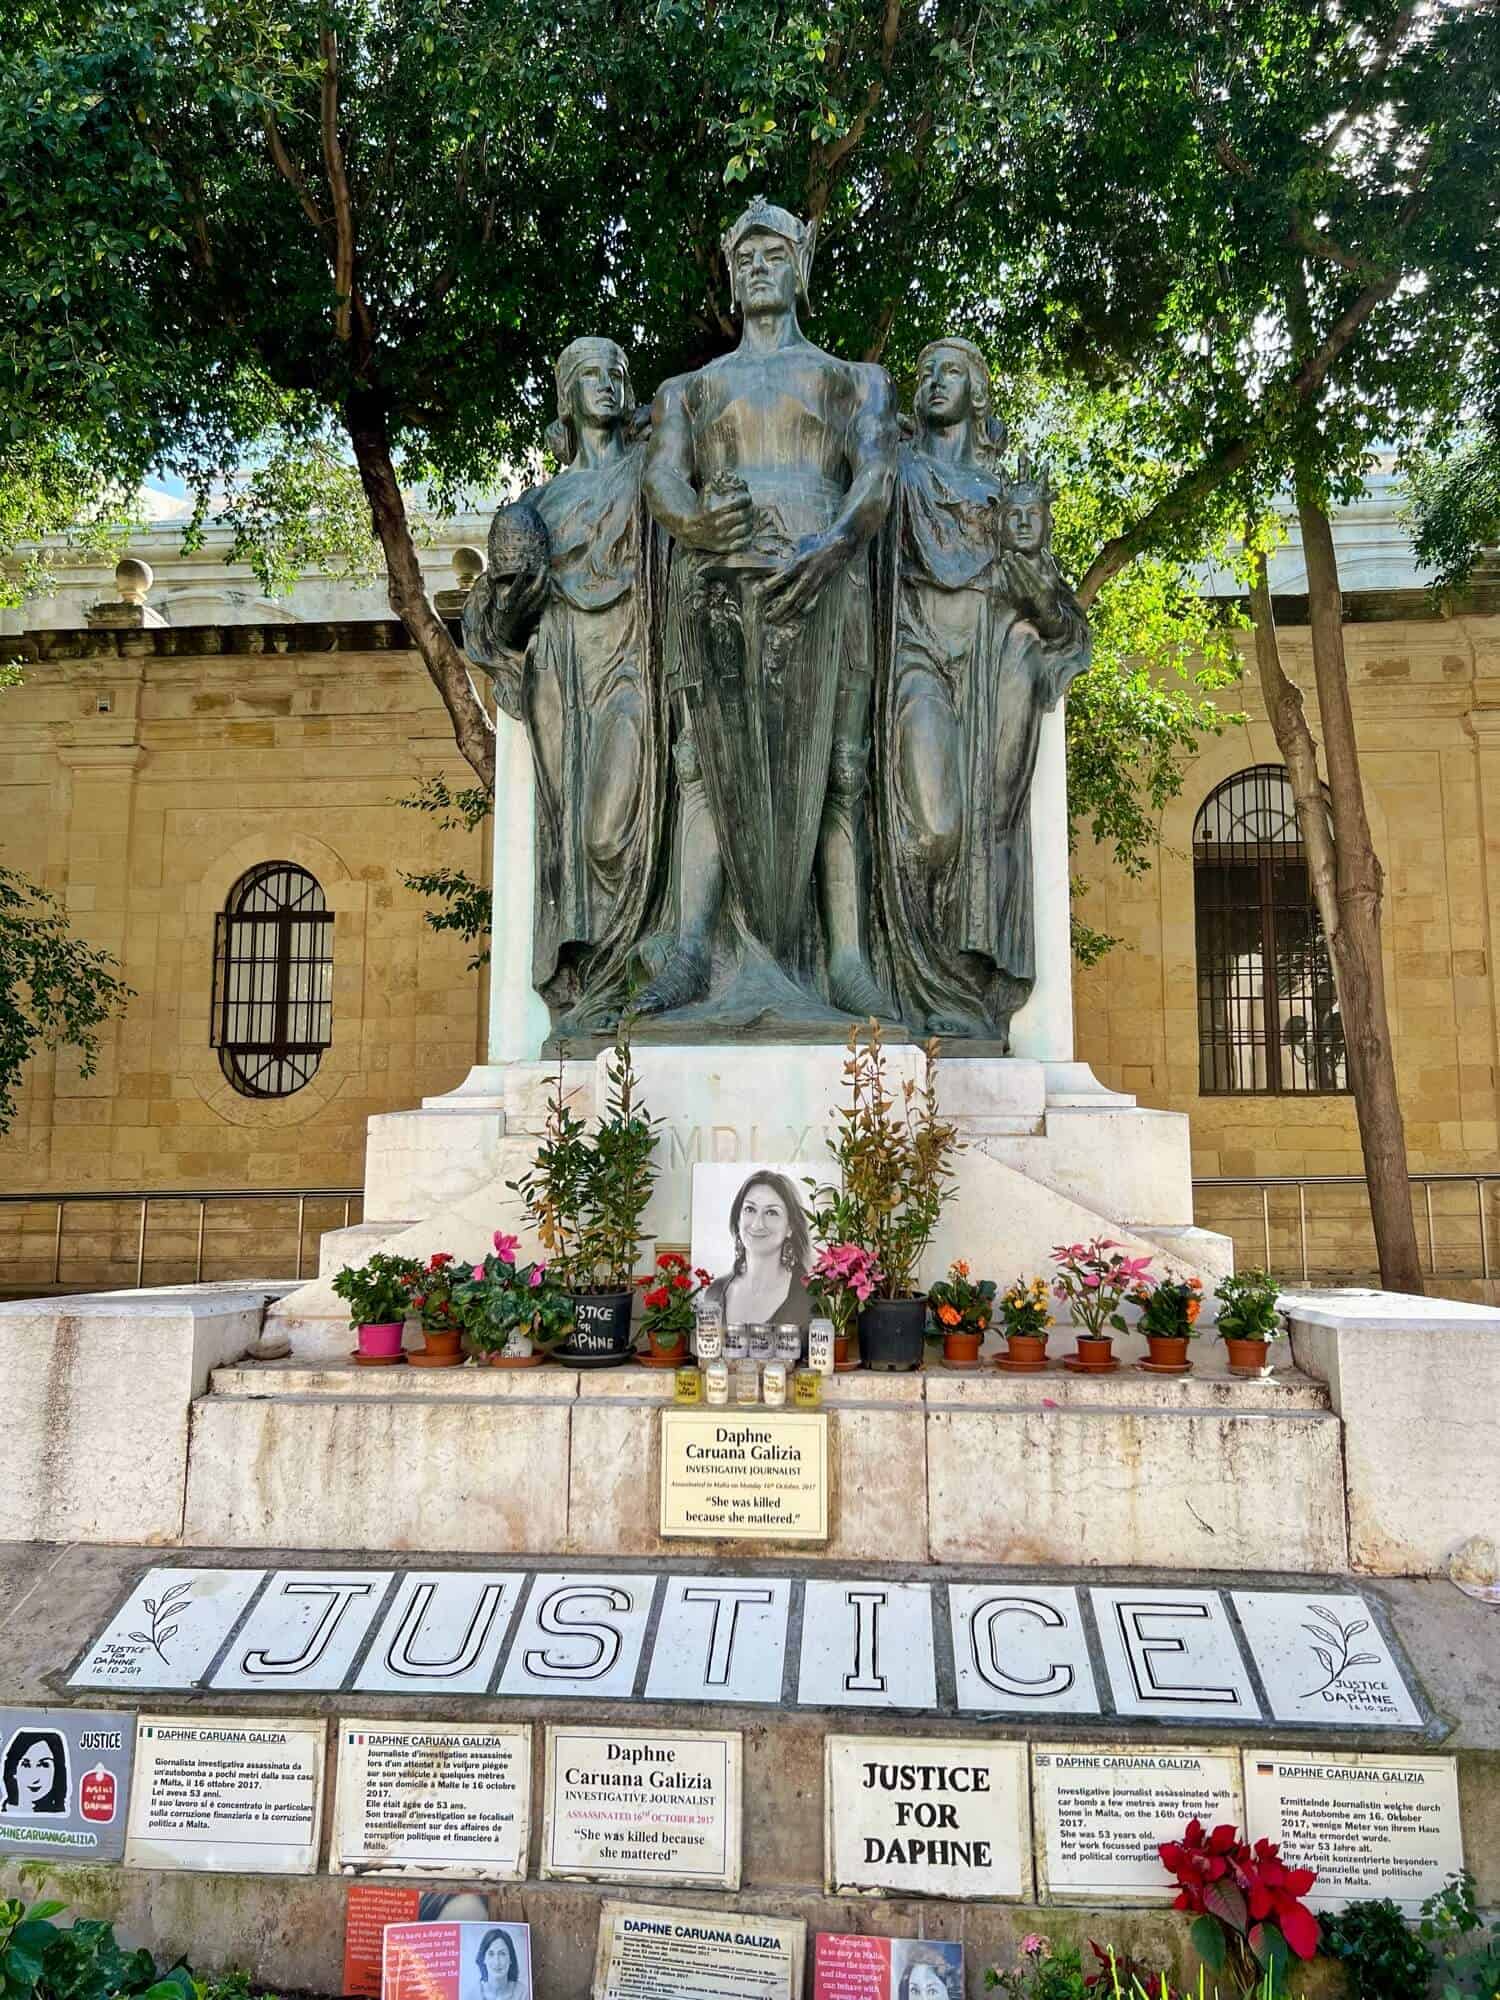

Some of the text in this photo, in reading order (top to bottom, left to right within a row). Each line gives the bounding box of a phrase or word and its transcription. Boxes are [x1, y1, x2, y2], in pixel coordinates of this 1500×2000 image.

[716, 1427, 771, 1445] Daphne
[686, 1444, 800, 1460] Caruana Galizia
[686, 1465, 800, 1476] INVESTIGATIVE JOURNALIST
[732, 1499, 750, 1507] was
[753, 1497, 780, 1508] killed
[686, 1510, 725, 1522] because
[728, 1511, 744, 1522] she
[242, 1583, 1240, 1704] JUSTICE
[93, 1657, 137, 1665] DAPHNE
[1335, 1680, 1388, 1690] JUSTICE
[1322, 1691, 1393, 1704] DAPHNE
[80, 1732, 121, 1748] JUSTICE
[158, 1730, 286, 1742] DAPHNE CARUANA GALIZIA
[368, 1735, 501, 1746] DAPHNE CARUANA GALIZIA
[607, 1744, 675, 1764] Daphne
[155, 1758, 195, 1766] Giornalista
[197, 1759, 244, 1768] investigativa
[246, 1761, 290, 1769] assassinata
[1056, 1758, 1200, 1768] DAPHNE CARUANA GALIZIA
[154, 1769, 206, 1777] un'autobomba
[215, 1770, 236, 1778] pochi
[565, 1768, 711, 1789] Caruana Galizia
[862, 1763, 990, 1792] JUSTICE
[1279, 1767, 1424, 1782] DAPHNE CARUANA GALIZIA
[160, 1779, 184, 1787] Malta,
[206, 1780, 235, 1788] ottobre
[237, 1781, 261, 1789] 2017.
[565, 1791, 715, 1805] INVESTIGATIVE JOURNALIST
[1057, 1787, 1110, 1796] Investigative
[1112, 1788, 1152, 1797] journalist
[1154, 1789, 1209, 1797] assassinated
[1212, 1790, 1230, 1798] with
[1280, 1797, 1440, 1812] Ermittelnde Journalistin welche durch
[895, 1801, 959, 1829] FOR
[1095, 1809, 1121, 1817] Malta,
[1155, 1810, 1175, 1818] 16th
[1177, 1811, 1212, 1819] October
[1281, 1809, 1298, 1817] eine
[1301, 1810, 1350, 1819] Autobombe
[1369, 1812, 1384, 1821] 16.
[1386, 1813, 1422, 1822] Oktober
[148, 1820, 176, 1828] politica
[186, 1821, 209, 1829] Malta.
[1060, 1819, 1086, 1827] 2017.
[604, 1832, 624, 1841] was
[627, 1830, 657, 1843] killed
[661, 1831, 704, 1844] because
[1060, 1830, 1076, 1838] She
[1138, 1831, 1155, 1839] old.
[1282, 1830, 1390, 1842] in Malta ermordet wurde.
[1078, 1841, 1099, 1849] work
[1102, 1841, 1140, 1850] focussed
[1283, 1841, 1296, 1849] Sie
[1317, 1842, 1330, 1851] 53
[1333, 1843, 1356, 1852] Jahre
[1358, 1844, 1372, 1852] alt.
[599, 1846, 617, 1858] she
[864, 1838, 991, 1868] DAPHNE
[1061, 1852, 1076, 1860] and
[1079, 1853, 1112, 1861] political
[624, 1920, 781, 1950] DAPHNE CARUANA GALIZIA
